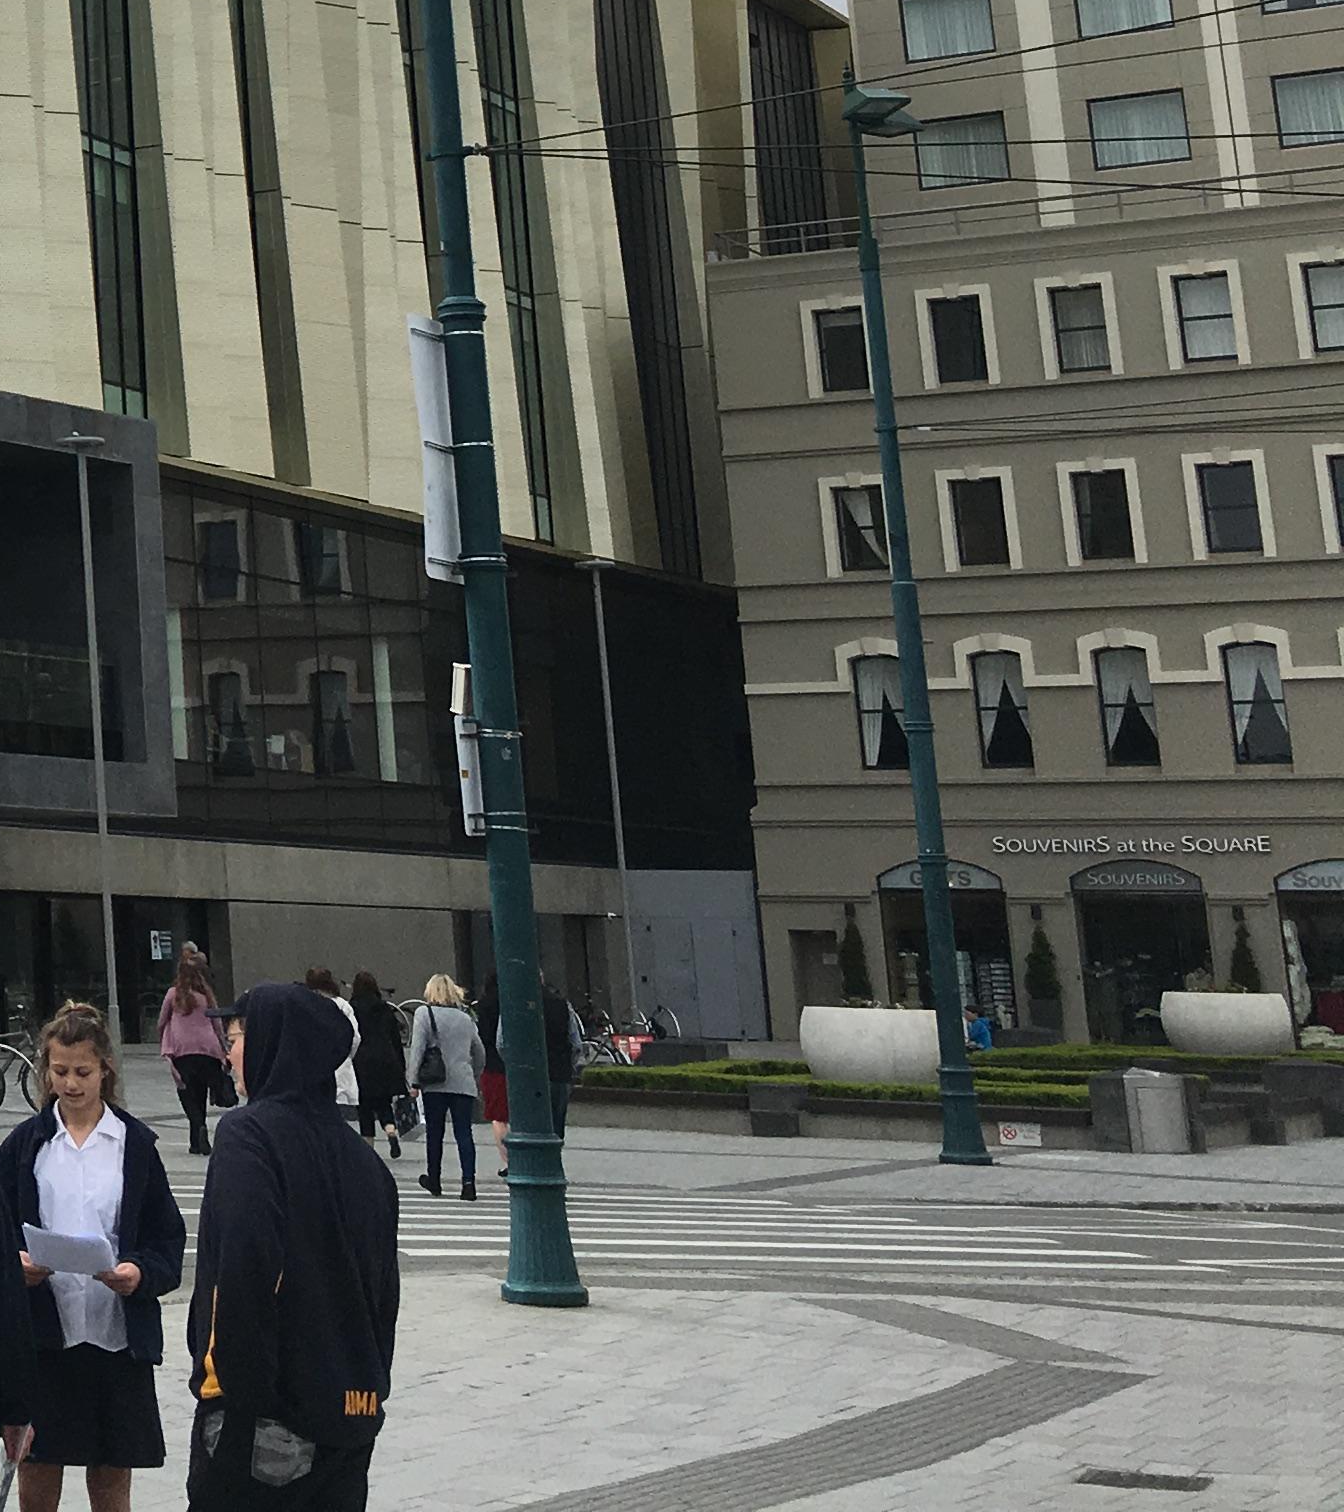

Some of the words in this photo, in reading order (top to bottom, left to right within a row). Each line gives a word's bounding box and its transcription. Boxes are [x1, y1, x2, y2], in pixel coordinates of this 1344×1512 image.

[992, 836, 1110, 853] SOUVENIRS
[1117, 839, 1136, 852] at
[1142, 838, 1175, 852] the
[1181, 835, 1271, 855] SQUARE
[1087, 872, 1185, 885] SOUVENIRS
